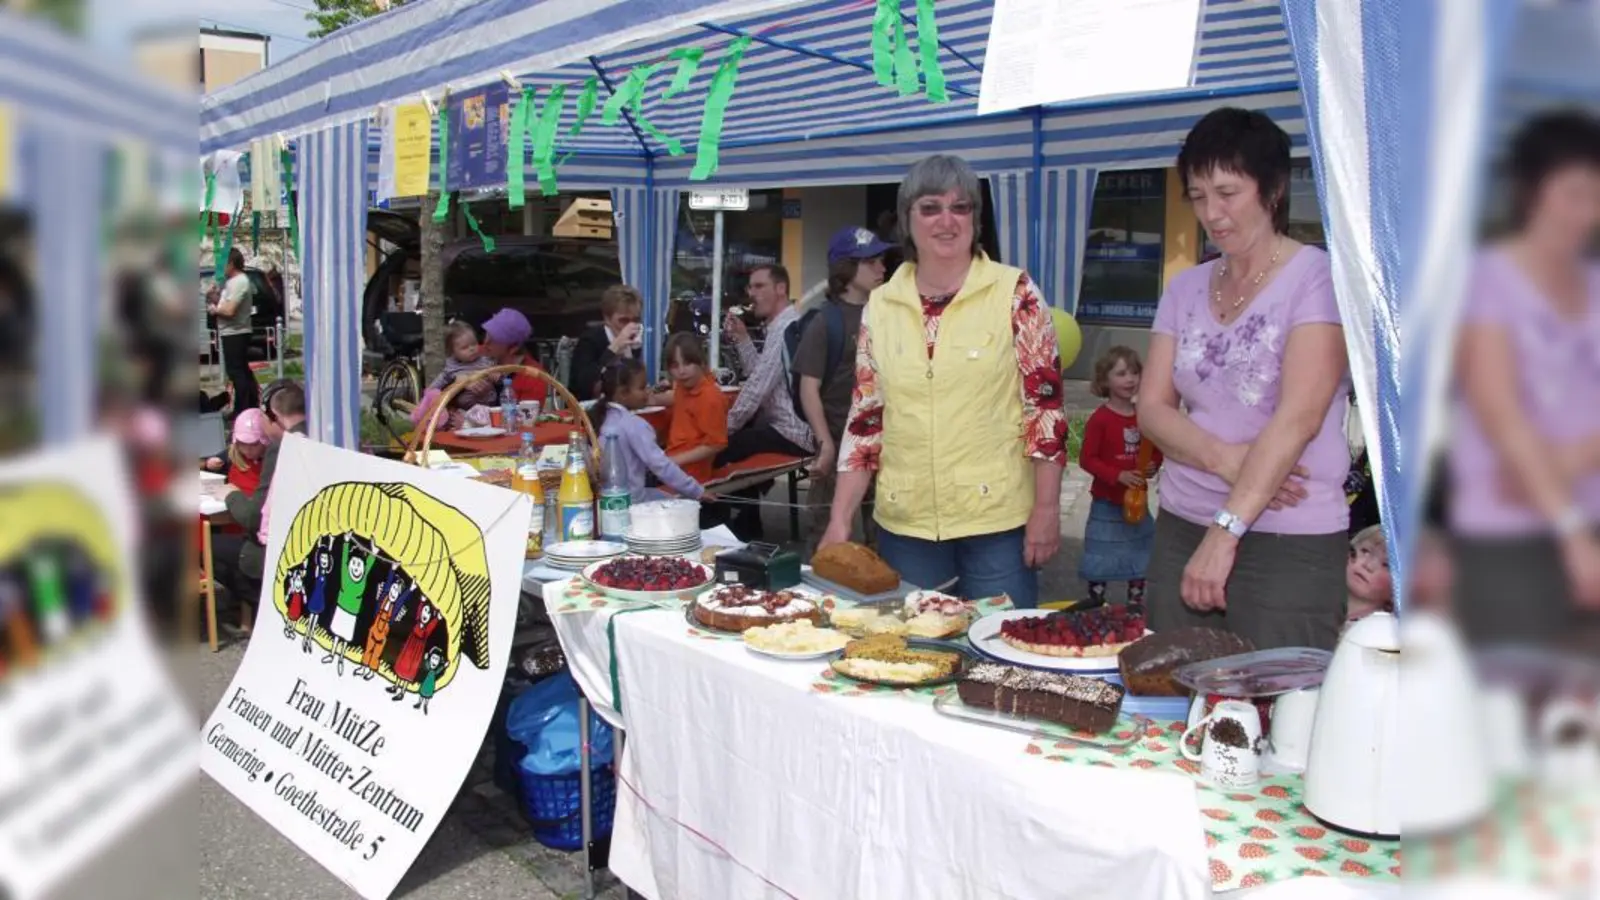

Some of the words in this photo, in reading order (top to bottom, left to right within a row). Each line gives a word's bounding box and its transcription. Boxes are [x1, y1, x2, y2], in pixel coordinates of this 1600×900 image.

[227, 686, 273, 732] Frauen
[271, 720, 303, 749] und
[296, 731, 425, 833] Mütter-Zentrum
[285, 677, 326, 722] Frau
[325, 700, 386, 758] MütZe
[206, 722, 267, 782] Germering
[274, 772, 365, 851] Goethestraße
[362, 835, 386, 861] 5
